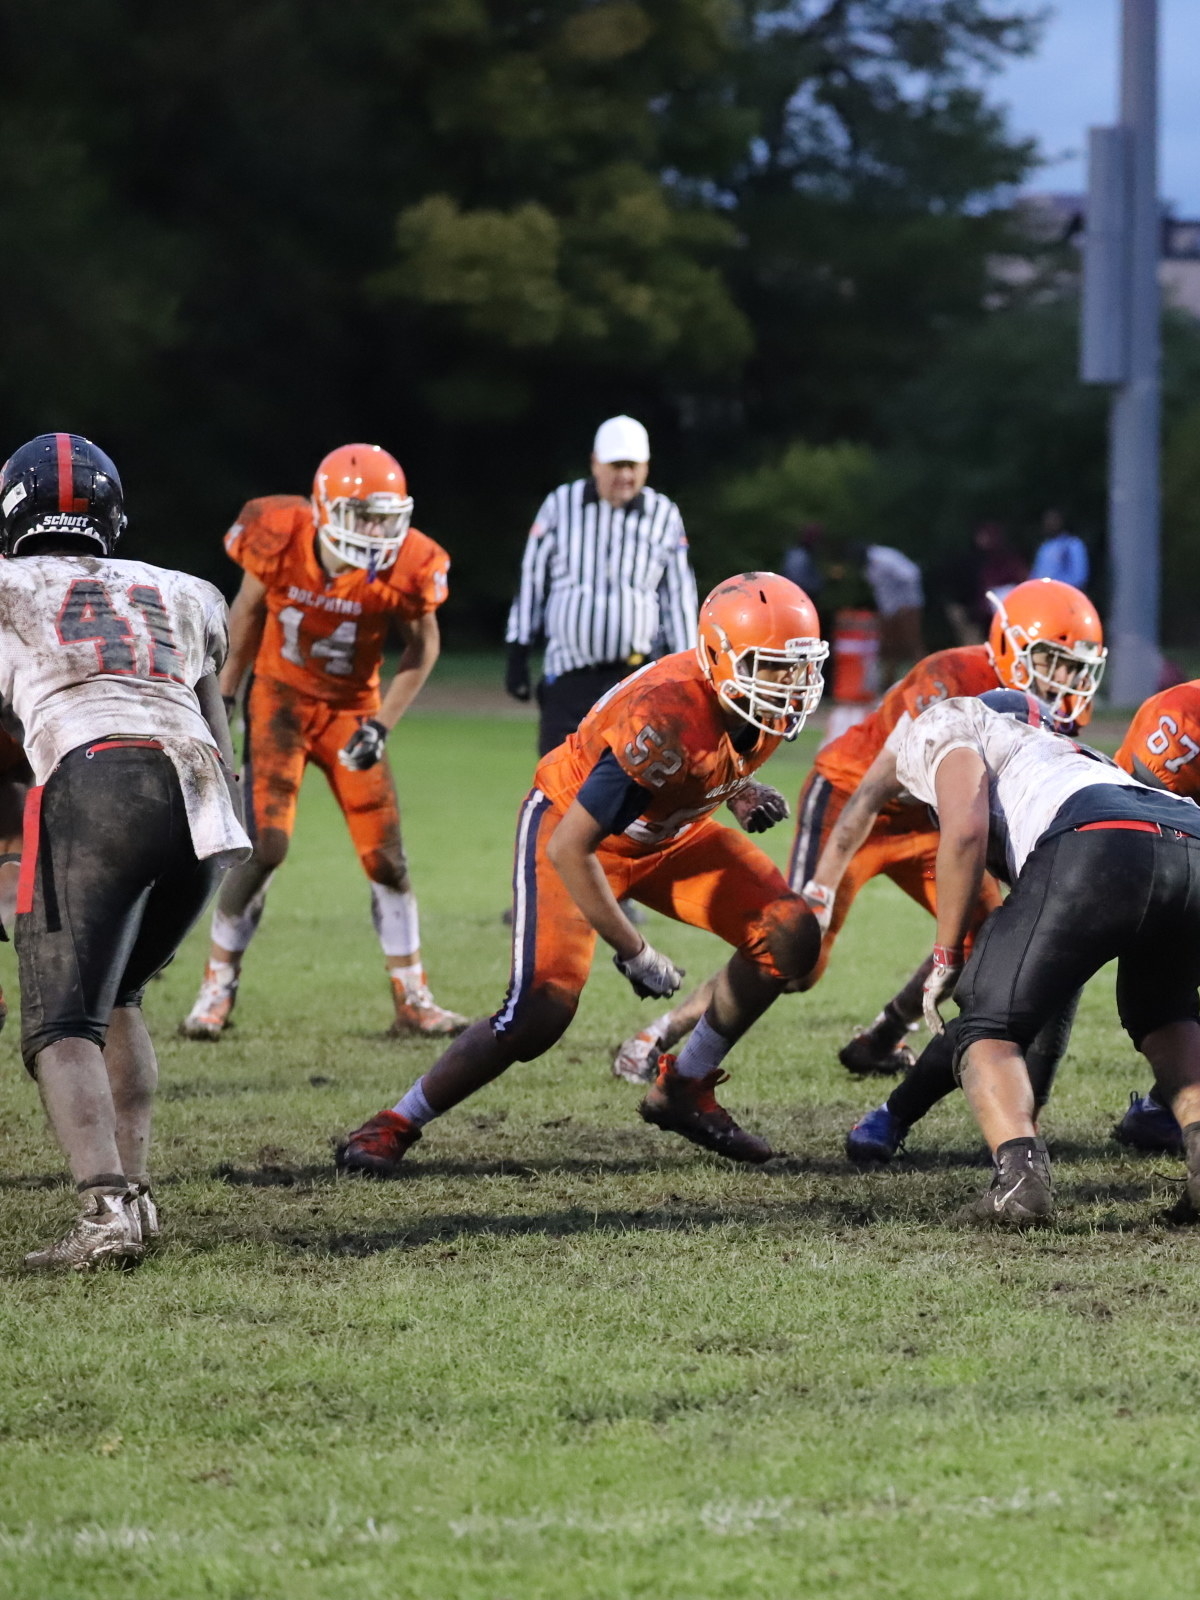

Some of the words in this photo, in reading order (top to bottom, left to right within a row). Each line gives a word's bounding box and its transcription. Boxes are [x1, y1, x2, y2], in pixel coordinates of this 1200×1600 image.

[42, 512, 89, 528] schutt
[55, 578, 186, 683] 41
[278, 606, 358, 675] 14
[625, 724, 683, 788] 52
[1146, 714, 1200, 774] 67
